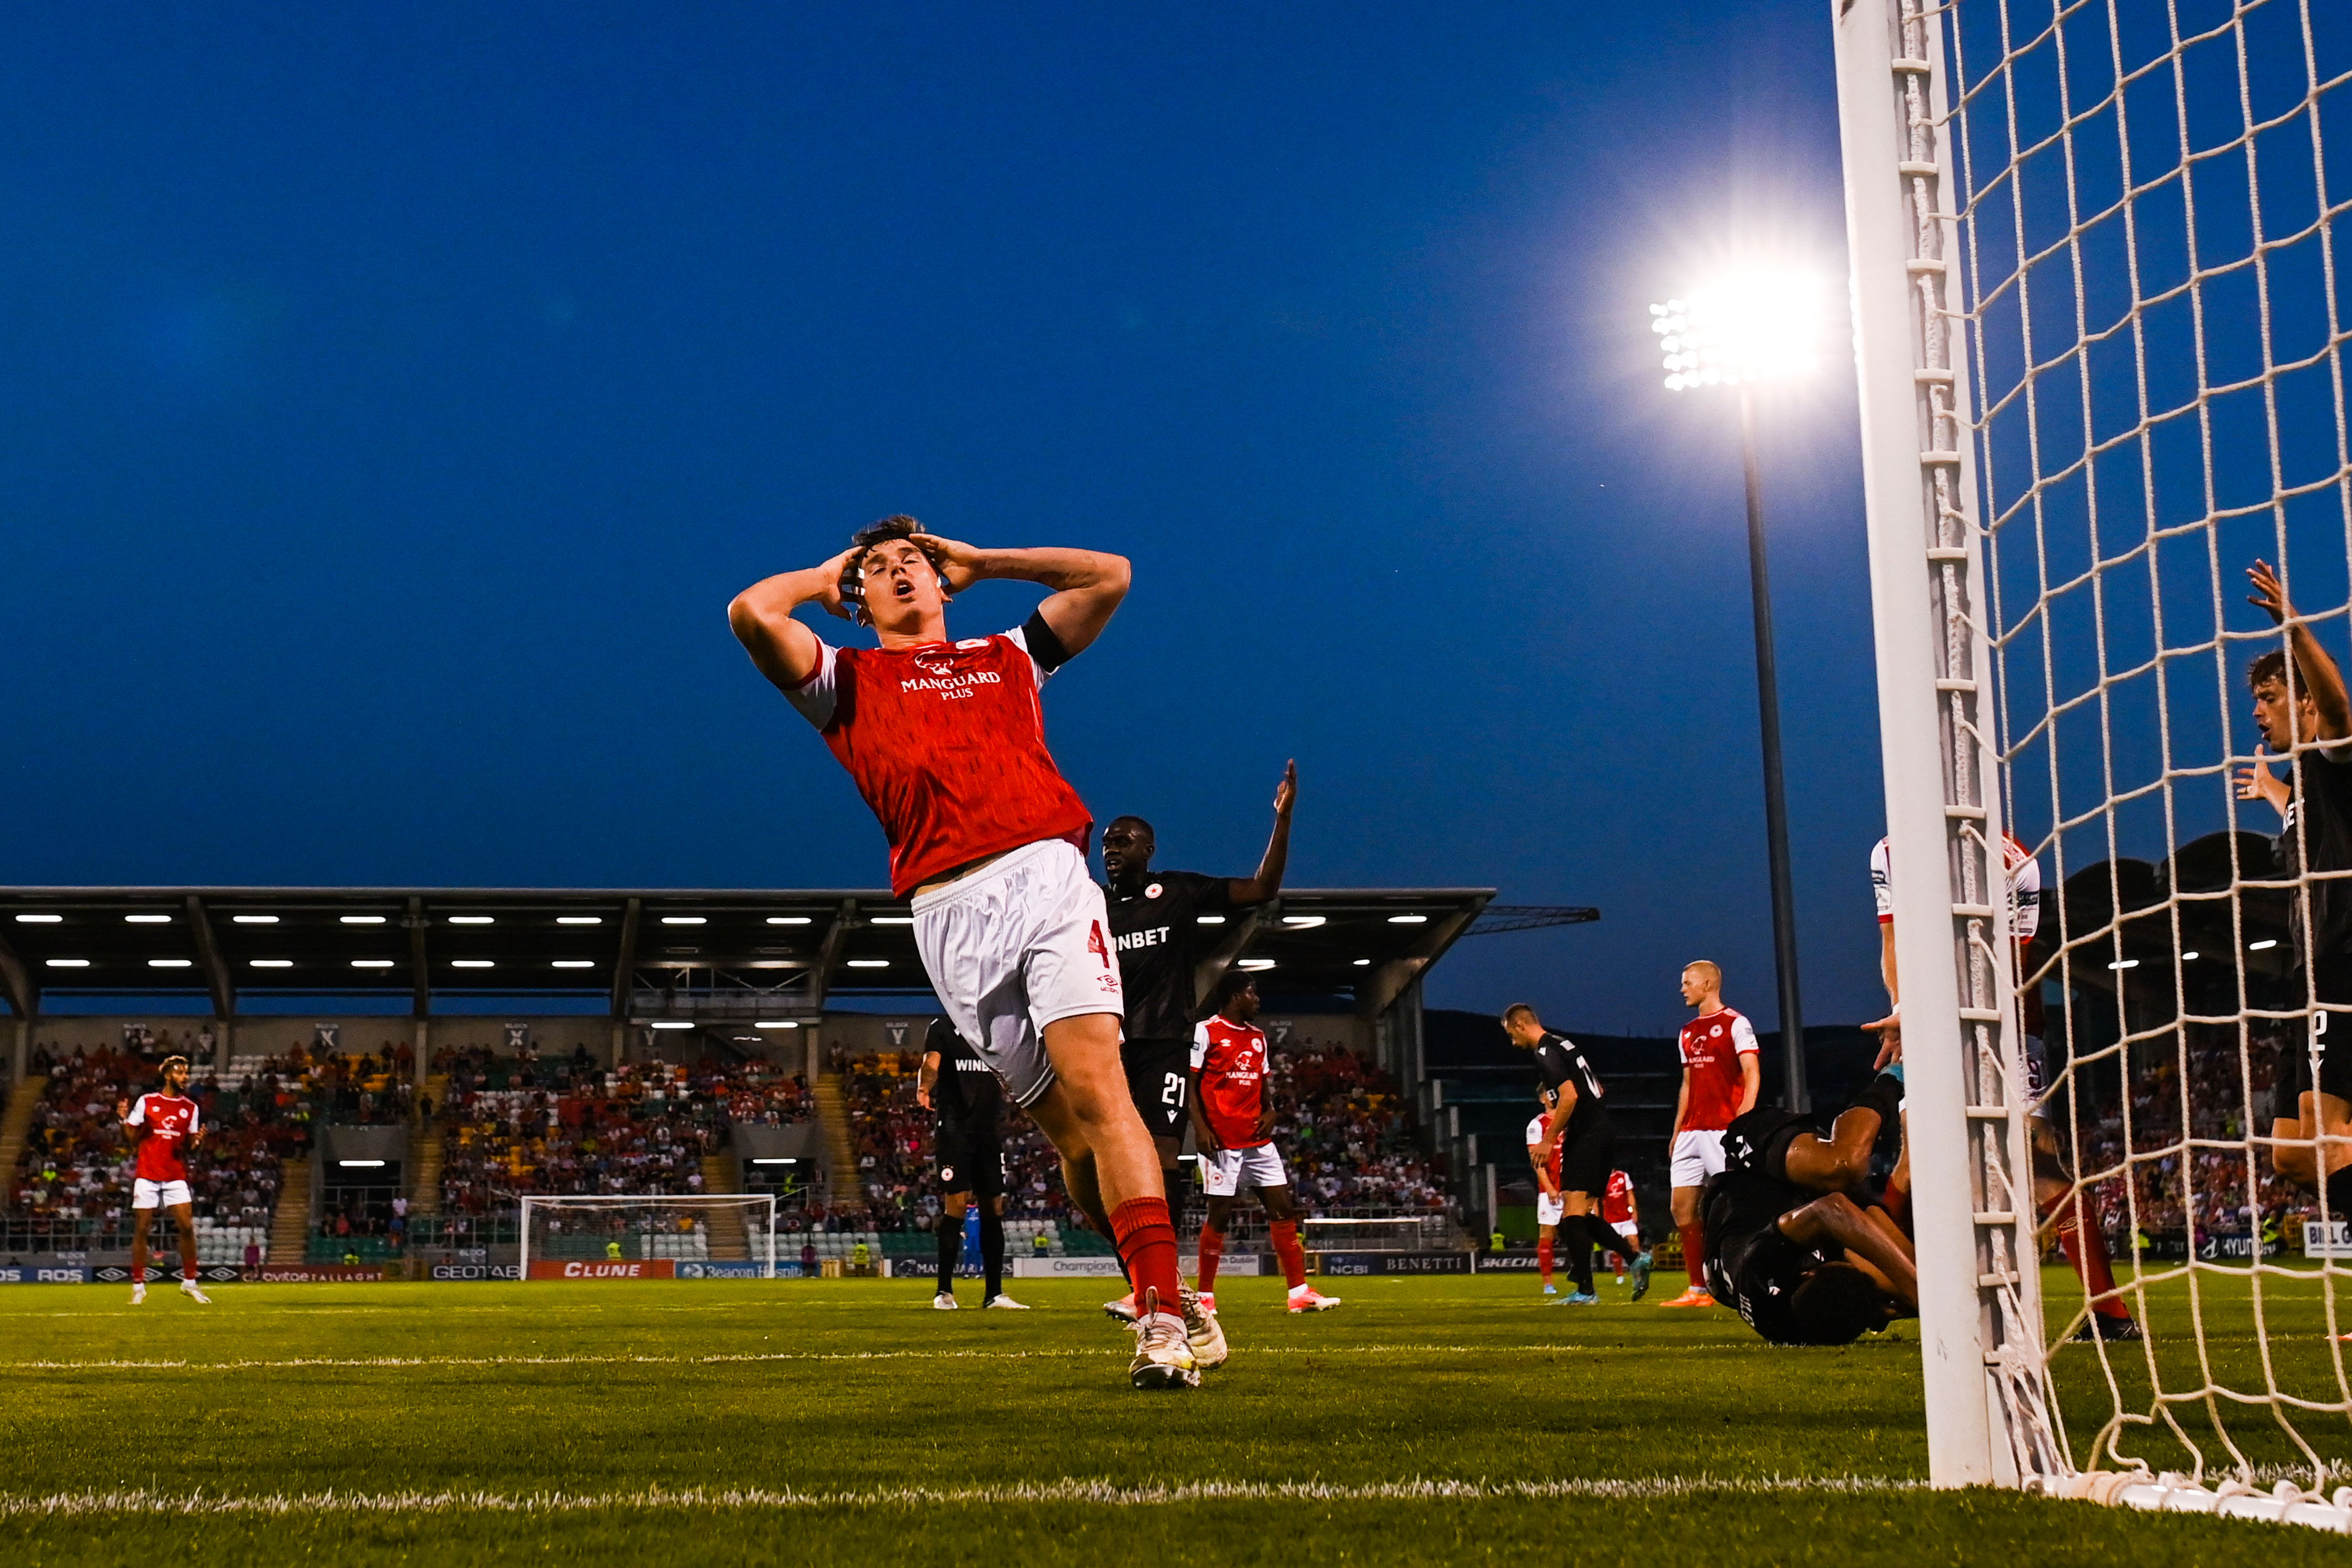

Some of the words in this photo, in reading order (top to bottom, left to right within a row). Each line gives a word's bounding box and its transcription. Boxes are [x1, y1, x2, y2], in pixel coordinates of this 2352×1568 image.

[901, 672, 1001, 692] MANGUARD
[940, 688, 974, 700] PLUS
[1088, 919, 1110, 969] 4
[1112, 926, 1170, 952] INBET
[955, 1059, 989, 1071] WINB
[1161, 1072, 1185, 1107] 21
[564, 1259, 641, 1277] CLUNE
[1053, 1260, 1117, 1273] Champions
[1330, 1265, 1368, 1274] NCBI
[1387, 1258, 1462, 1270] BENETTI
[434, 1266, 520, 1279] GEOTAB
